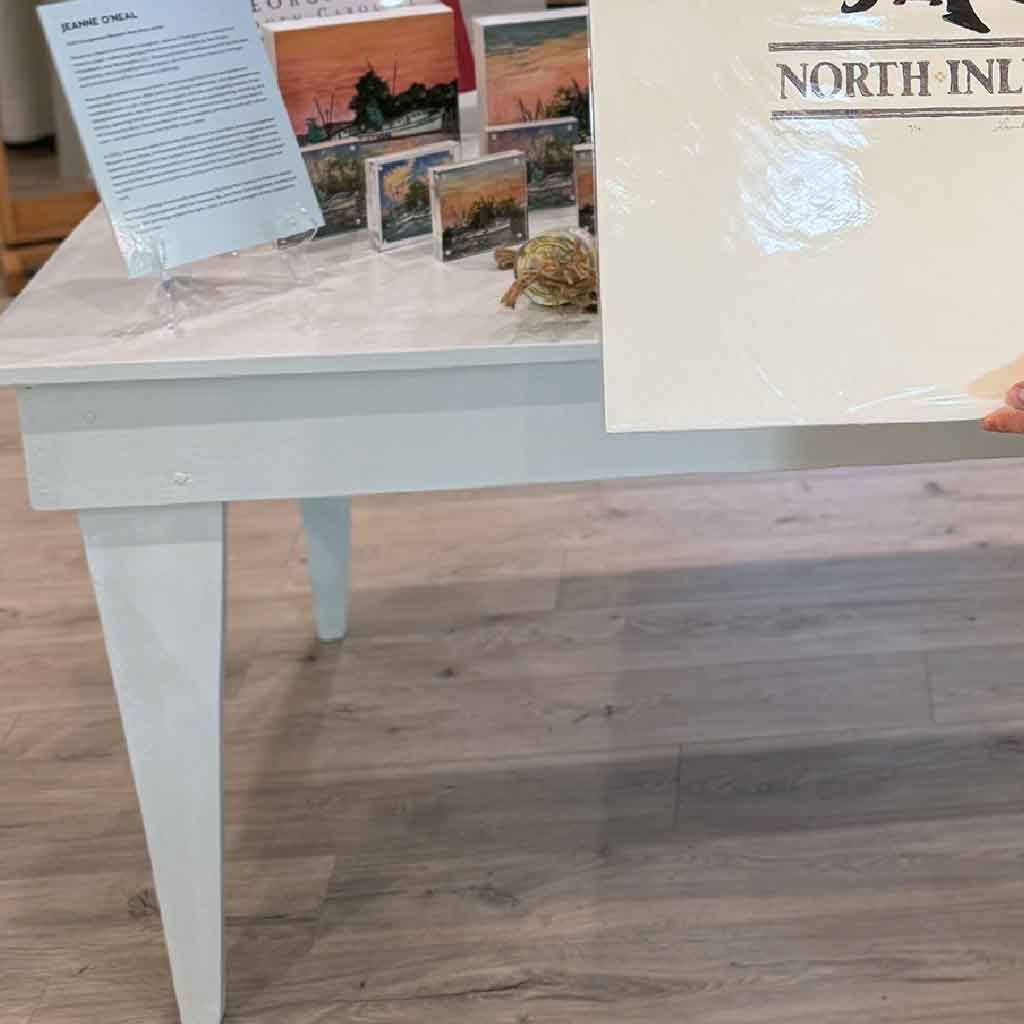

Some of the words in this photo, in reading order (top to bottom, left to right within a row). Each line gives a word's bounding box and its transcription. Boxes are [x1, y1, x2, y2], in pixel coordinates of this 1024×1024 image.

[60, 17, 99, 33] JEANNE
[101, 10, 139, 25] O'NEAL
[776, 60, 932, 100] NORTH
